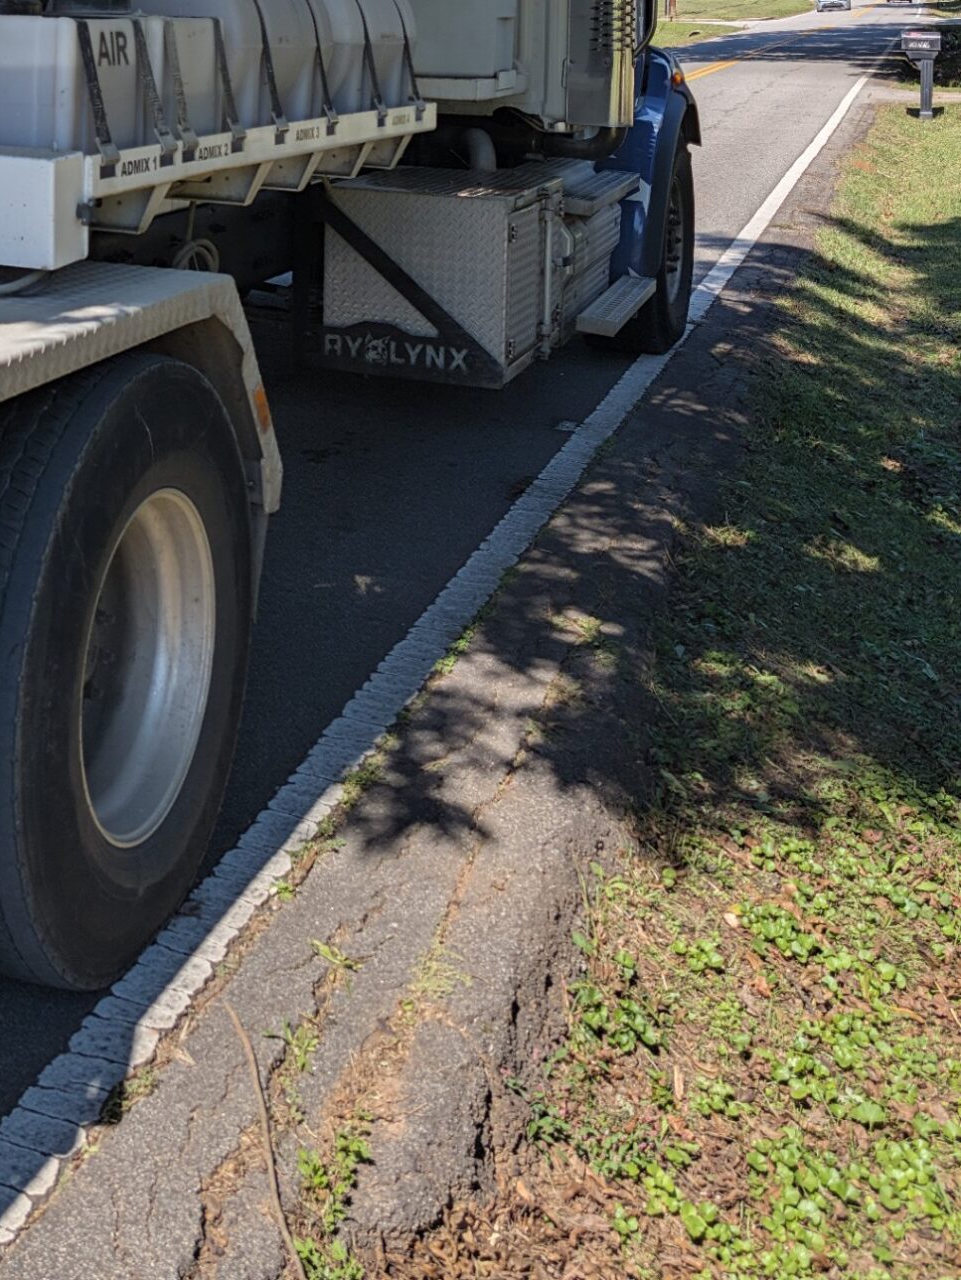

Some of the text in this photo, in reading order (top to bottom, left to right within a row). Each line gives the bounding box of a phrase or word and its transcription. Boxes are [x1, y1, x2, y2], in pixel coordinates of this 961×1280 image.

[98, 31, 129, 66] AIR
[296, 127, 315, 141] ADMIX
[198, 143, 229, 160] ADMIX 2
[121, 156, 158, 177] ADMIX 1
[390, 340, 469, 375] LYNX
